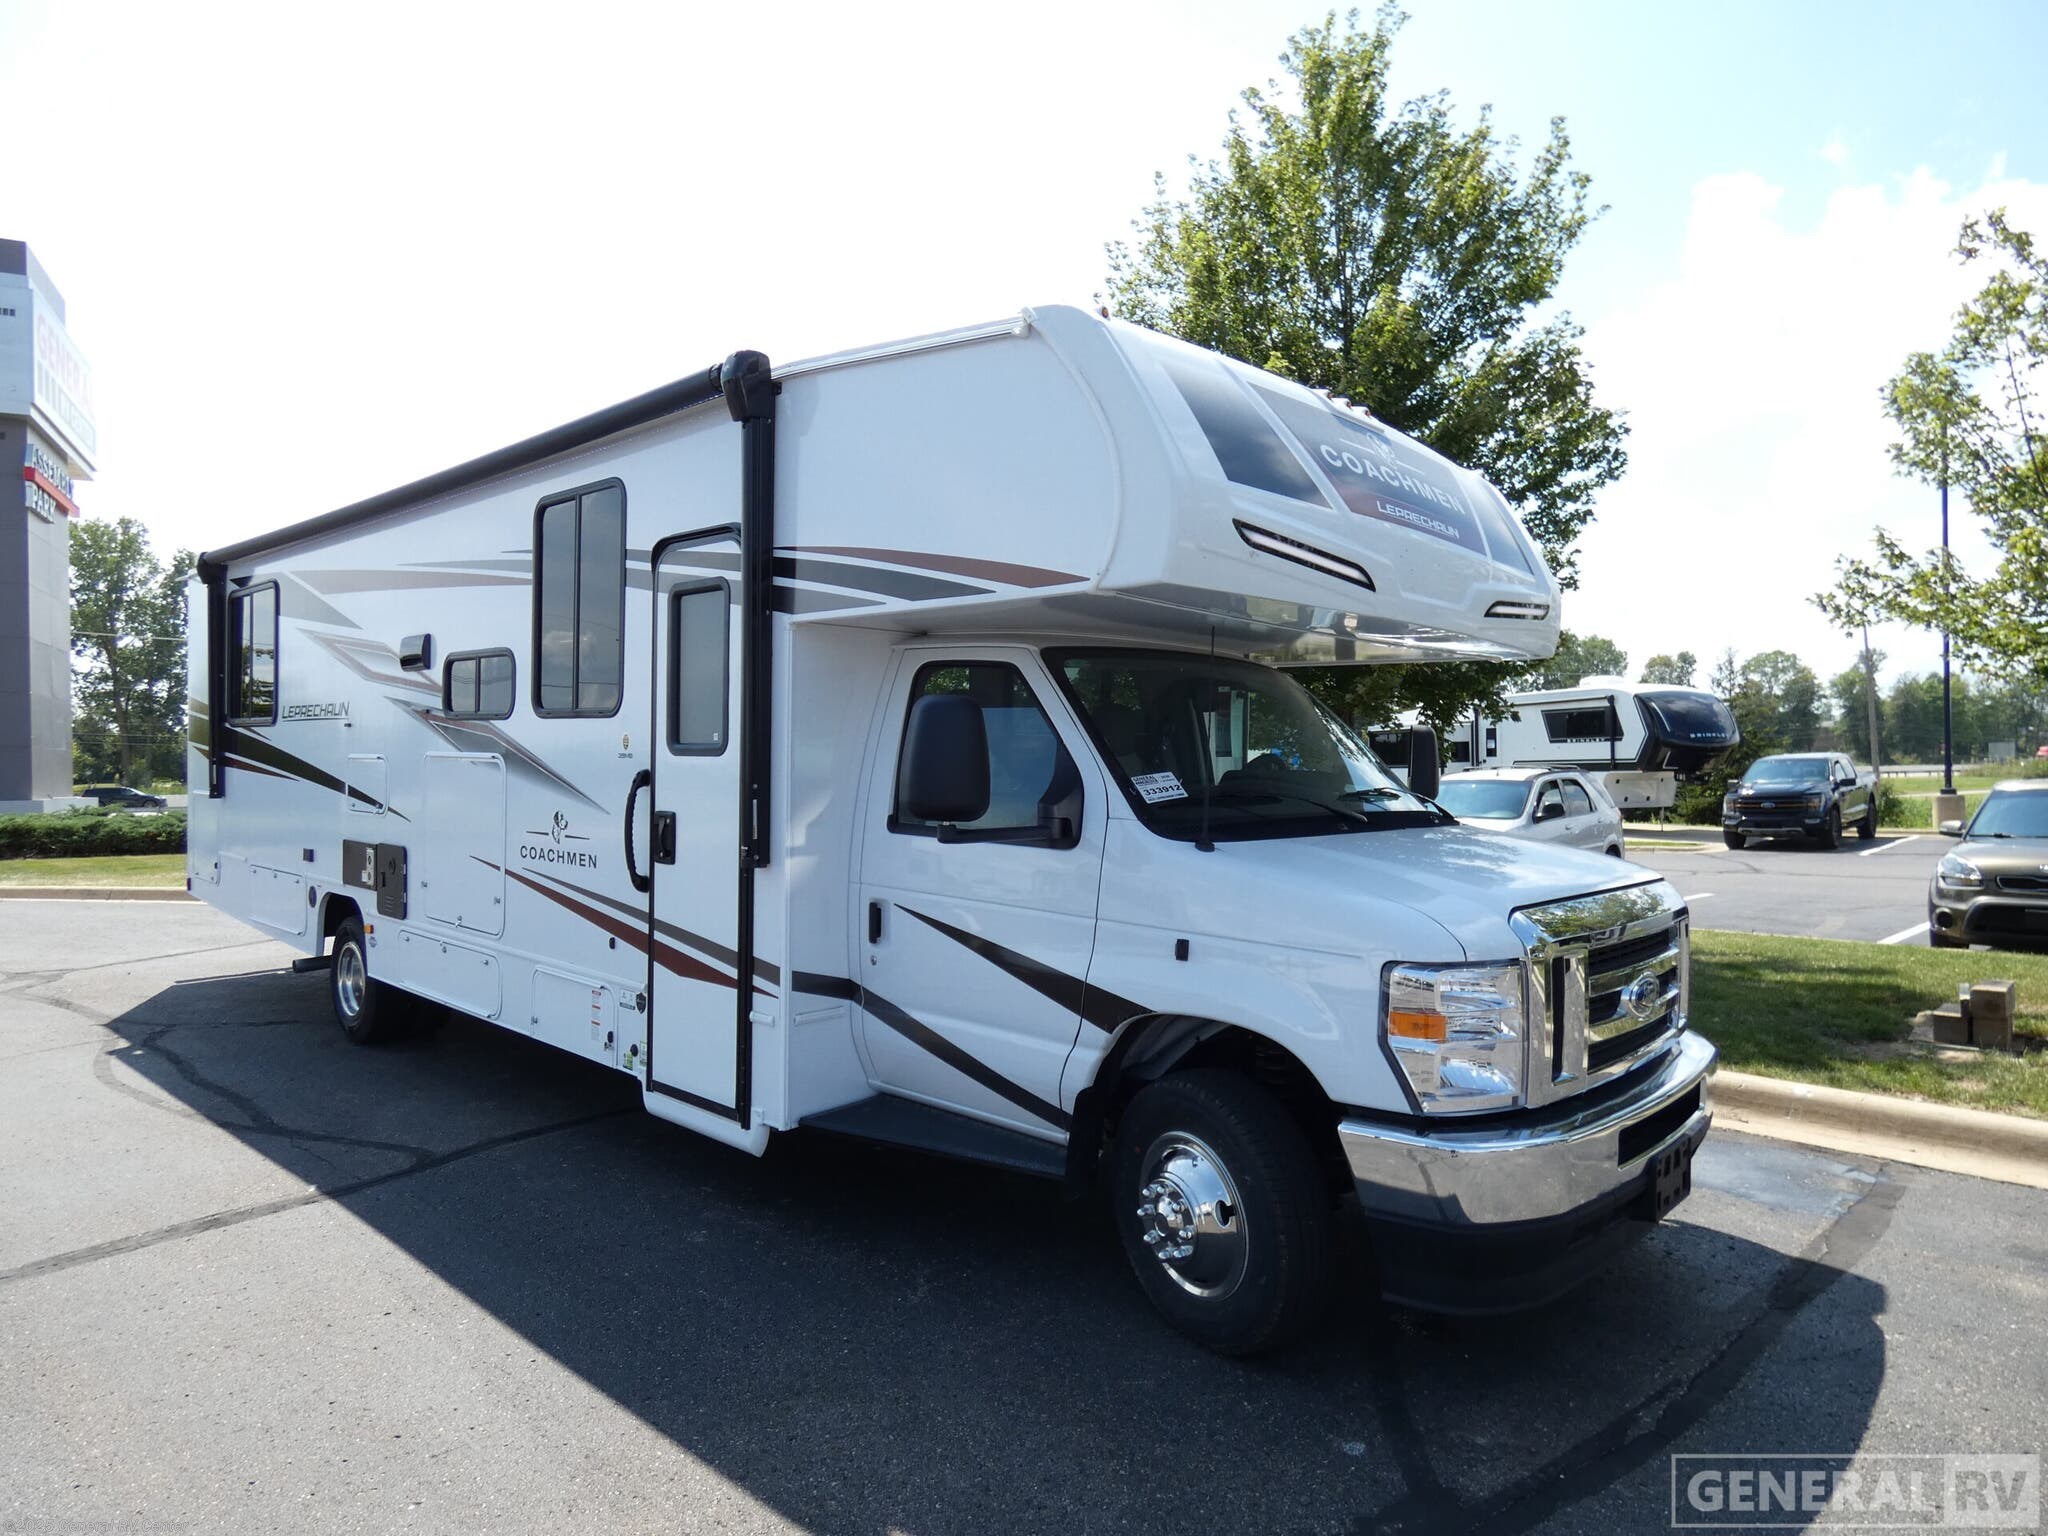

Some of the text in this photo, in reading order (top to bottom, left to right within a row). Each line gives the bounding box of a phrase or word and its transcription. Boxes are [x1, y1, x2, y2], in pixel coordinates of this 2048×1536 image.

[1319, 443, 1467, 514] COACHMEN
[1376, 500, 1460, 539] LEPRECHAUN
[281, 701, 350, 719] LEPRECHAUN
[1143, 784, 1182, 796] 333912
[520, 845, 598, 869] COACHMEN
